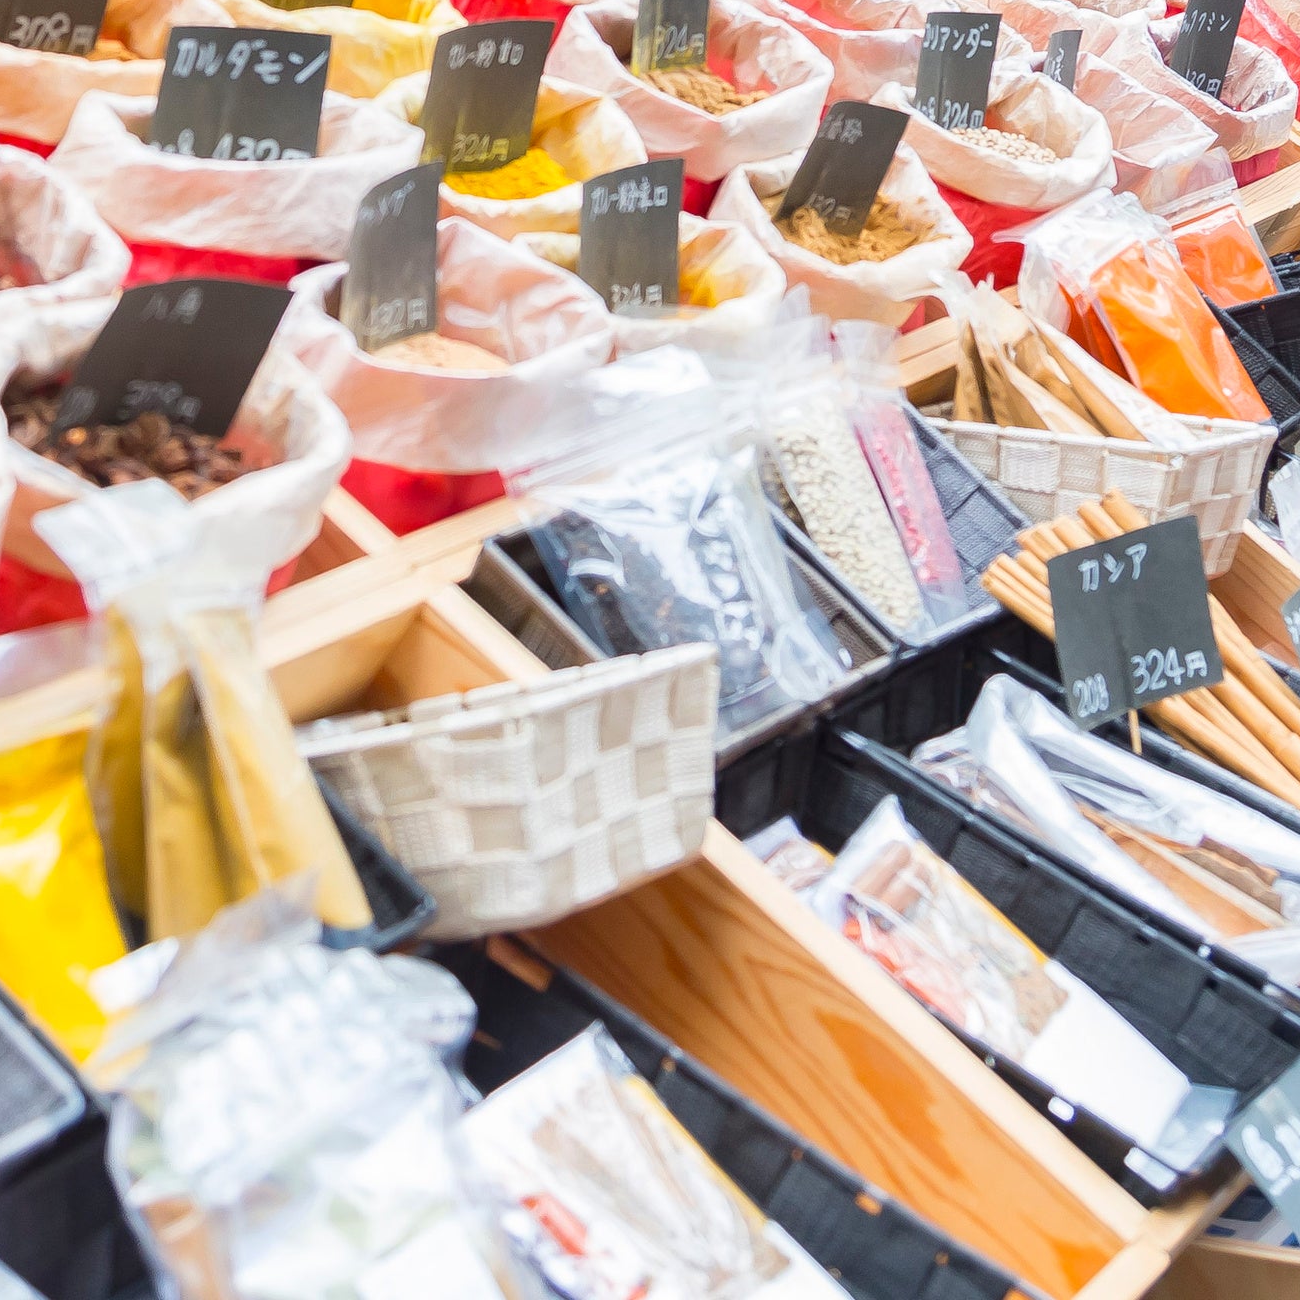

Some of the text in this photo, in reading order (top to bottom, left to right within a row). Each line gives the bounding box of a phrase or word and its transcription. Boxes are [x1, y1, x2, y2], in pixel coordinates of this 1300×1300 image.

[172, 37, 329, 85] カルダモン
[1076, 542, 1148, 594] カシア
[1130, 646, 1209, 696] 324円
